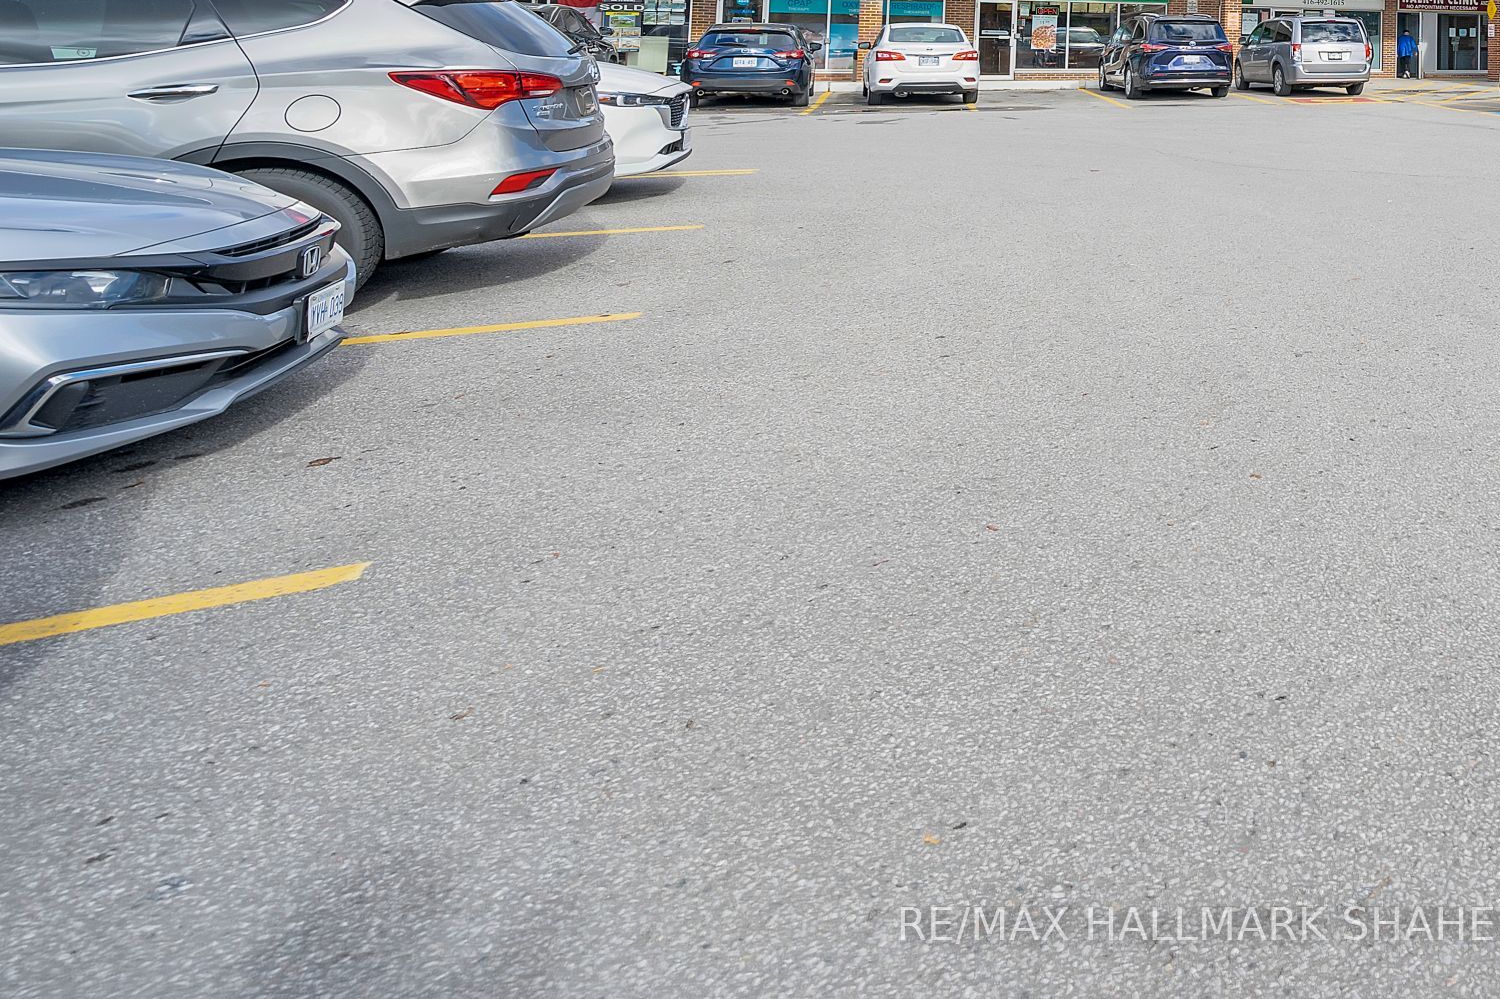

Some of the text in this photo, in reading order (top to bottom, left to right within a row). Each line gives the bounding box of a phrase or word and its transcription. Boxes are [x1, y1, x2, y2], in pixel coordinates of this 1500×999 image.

[600, 3, 645, 11] SOLD
[787, 0, 812, 7] CPAP
[1037, 7, 1058, 15] OPEN
